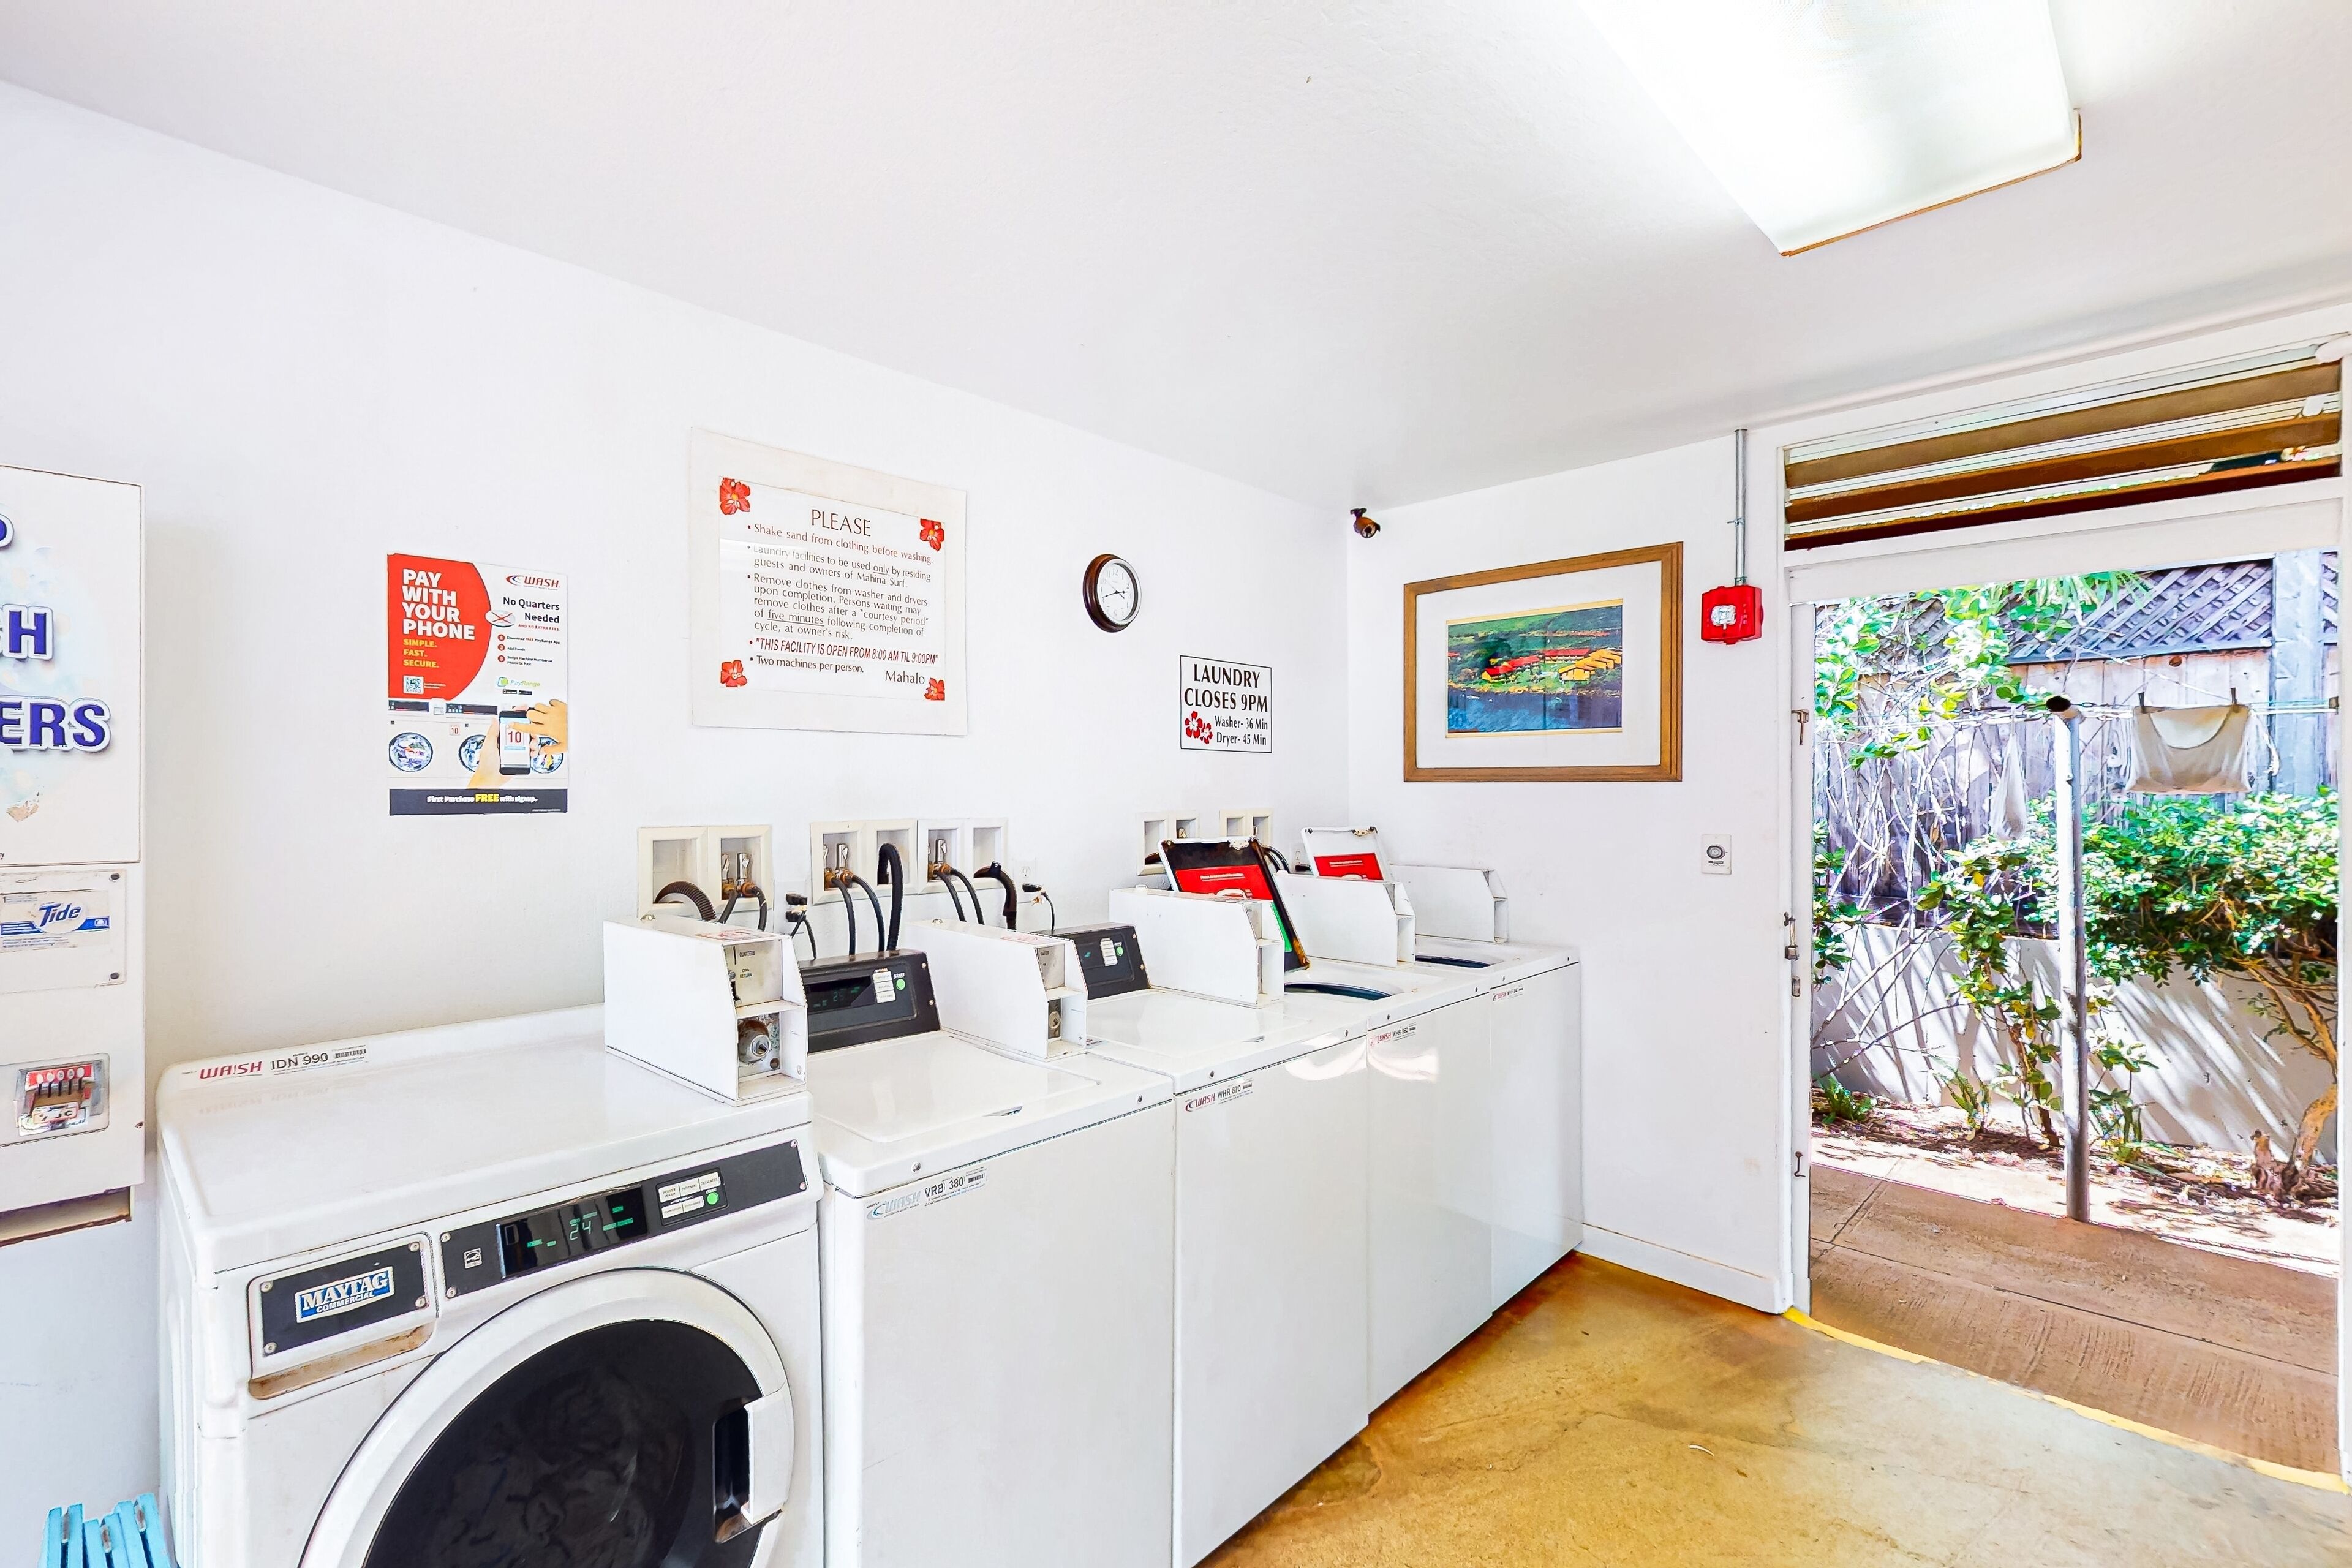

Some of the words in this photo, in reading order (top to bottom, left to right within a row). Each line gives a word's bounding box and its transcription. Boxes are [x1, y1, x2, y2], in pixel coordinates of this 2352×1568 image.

[812, 509, 871, 537] PLEASE
[755, 523, 782, 537] Shake
[786, 531, 807, 541] sand
[812, 533, 832, 546] from
[836, 539, 869, 554] clothing
[872, 545, 898, 557] before
[901, 551, 933, 566] washing.
[754, 545, 789, 558] Laundry
[793, 551, 824, 564] facilities
[827, 556, 835, 565] to
[838, 557, 848, 567] be
[852, 561, 870, 570] used
[873, 564, 890, 575] only
[892, 566, 900, 577] by
[903, 568, 930, 582] residing
[754, 559, 784, 569] guests
[789, 563, 805, 572] and
[809, 567, 840, 578] owners
[845, 571, 853, 579] of
[856, 572, 886, 584] Mahina
[402, 568, 442, 587] PAY
[524, 576, 559, 588] WASH
[402, 585, 457, 606] WITH
[754, 573, 791, 587] Remove
[796, 579, 827, 592] clothes
[831, 584, 851, 595] from
[854, 589, 884, 600] washer
[887, 594, 902, 602] and
[904, 595, 927, 606] dryers
[503, 597, 516, 606] No
[518, 598, 560, 611] Quarters
[754, 586, 778, 596] upon
[782, 589, 835, 603] completion.
[839, 595, 870, 608] Persons
[873, 601, 902, 614] waiting
[905, 606, 921, 616] may
[754, 598, 789, 608] remove
[793, 600, 824, 613] clothes
[829, 605, 848, 616] after
[402, 601, 461, 623] YOUR
[524, 612, 559, 624] Needed
[754, 608, 764, 617] of
[768, 609, 784, 620] five
[789, 614, 824, 624] minutes
[827, 617, 865, 631] following
[869, 624, 913, 635] completion
[916, 627, 924, 636] of
[403, 619, 475, 640] PHONE
[754, 621, 781, 633] cycle,
[797, 627, 832, 637] owner's
[835, 630, 853, 639] risk.
[403, 638, 437, 648] SIMPLE.
[403, 649, 428, 657] FAST.
[756, 638, 778, 651] "THIS
[780, 640, 816, 655] FACILITY
[817, 644, 825, 655] IS
[826, 644, 848, 657] OPEN
[850, 646, 870, 659] FROM
[872, 649, 886, 661] 8:00
[888, 650, 899, 662] AM
[900, 651, 910, 662] TIL
[911, 652, 938, 665] 9:00PM"
[403, 659, 440, 668] SECURE.
[756, 655, 774, 666] Two
[777, 658, 816, 669] machines
[819, 662, 833, 672] per
[835, 663, 864, 673] person.
[885, 670, 925, 685] Mahalo
[1194, 663, 1260, 688] LAUNDRY
[1184, 688, 1236, 710] CLOSES
[1241, 694, 1268, 712] 9PM
[1215, 715, 1243, 728] Washer-
[1245, 718, 1253, 729] 36
[1256, 718, 1268, 730] Min
[507, 731, 522, 744] 10
[1216, 731, 1240, 747] Dryer-
[1242, 734, 1251, 745] 45
[1253, 734, 1267, 745] Min
[475, 793, 499, 803] FREE
[39, 902, 81, 927] Tide
[271, 1057, 298, 1071] IDN
[302, 1052, 328, 1066] 990
[1195, 1093, 1216, 1107] WASH
[1217, 1088, 1231, 1099] WHR
[924, 1182, 944, 1198] VRB
[949, 1176, 965, 1190] 380
[570, 1221, 591, 1241] 24
[302, 1272, 388, 1311] MAYTAG
[316, 1291, 375, 1313] COMMERCIAL
